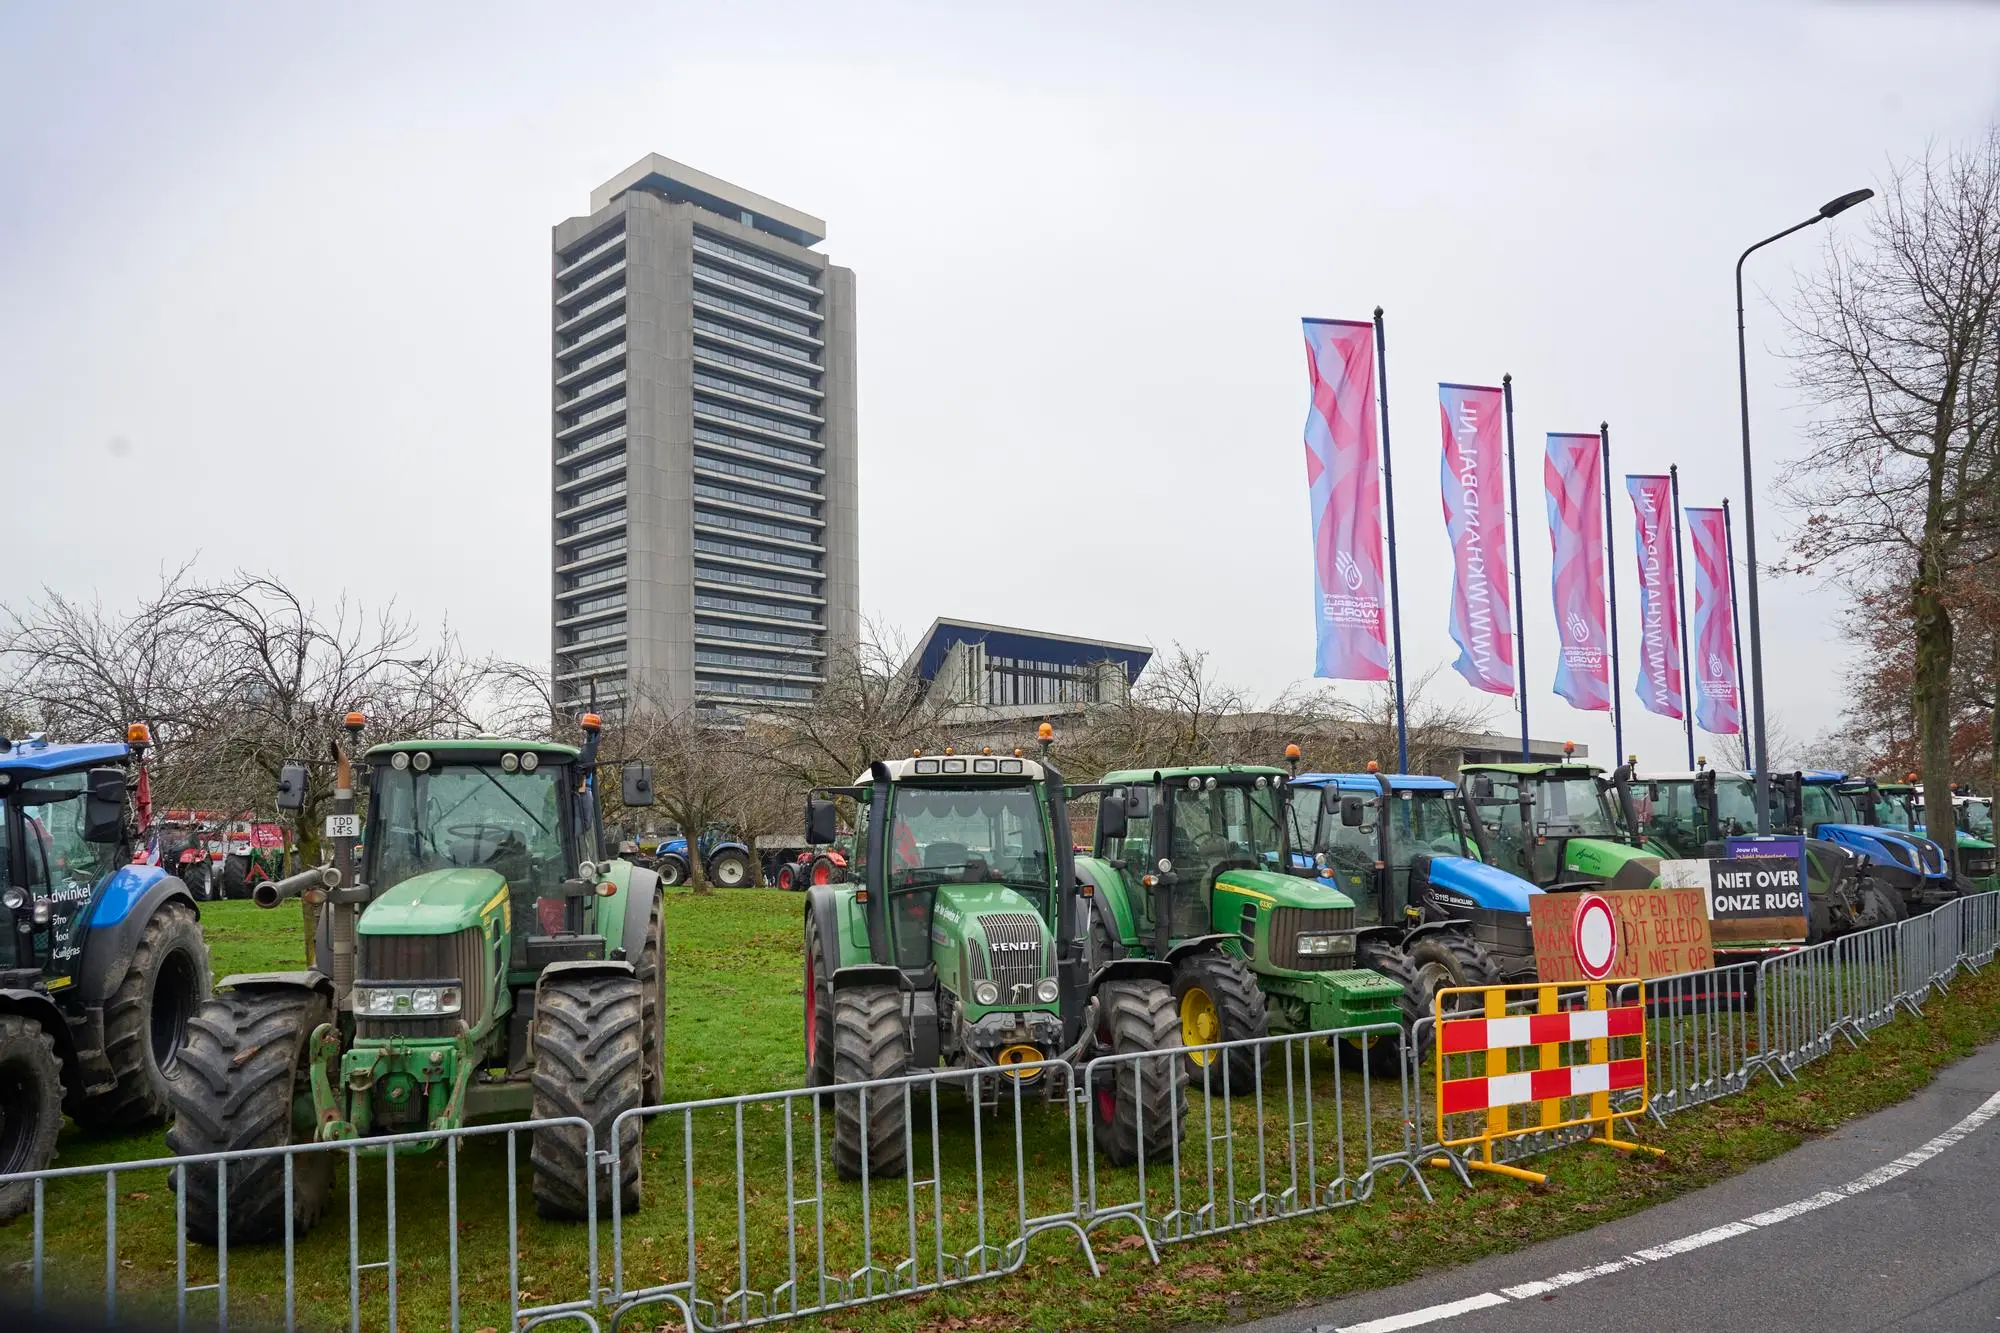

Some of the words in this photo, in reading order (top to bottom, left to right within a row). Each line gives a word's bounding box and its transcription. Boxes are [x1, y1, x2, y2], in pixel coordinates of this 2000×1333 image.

[332, 816, 353, 826] TDD
[1717, 872, 1752, 889] NIET
[1756, 870, 1800, 888] OVER
[1672, 892, 1700, 916] TOP
[1714, 893, 1760, 912] ONZE
[1765, 891, 1804, 910] RUG!
[1654, 915, 1703, 945] BELEID
[991, 941, 1038, 952] FENDT
[1648, 945, 1680, 976] NIET
